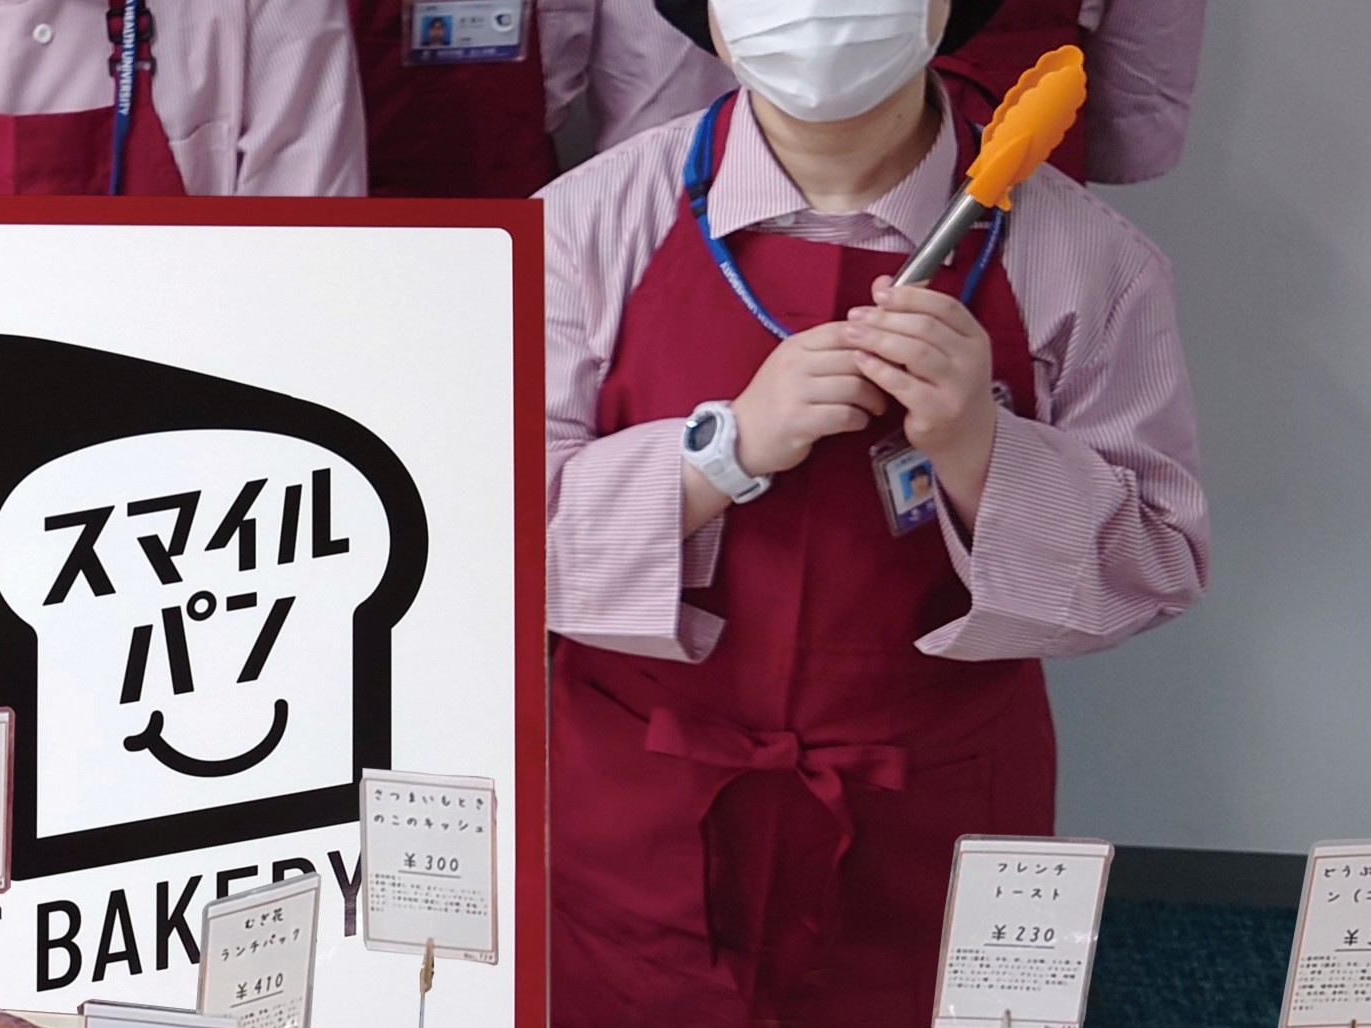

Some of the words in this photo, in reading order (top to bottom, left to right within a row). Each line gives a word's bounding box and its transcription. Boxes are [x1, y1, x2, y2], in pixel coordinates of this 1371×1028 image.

[42, 467, 350, 606] スマイル
[120, 590, 296, 704] パン
[374, 789, 484, 811] さつまいもとき
[373, 814, 484, 834] のこのキッシュ
[403, 852, 459, 872] ¥300
[997, 861, 1067, 876] フレンチ
[995, 886, 1061, 900] トースト
[37, 850, 362, 992] BAKY
[244, 907, 285, 930] むぎ花
[991, 924, 1055, 942] ¥230
[220, 928, 301, 962] ランチパック
[235, 972, 284, 1000] ¥410
